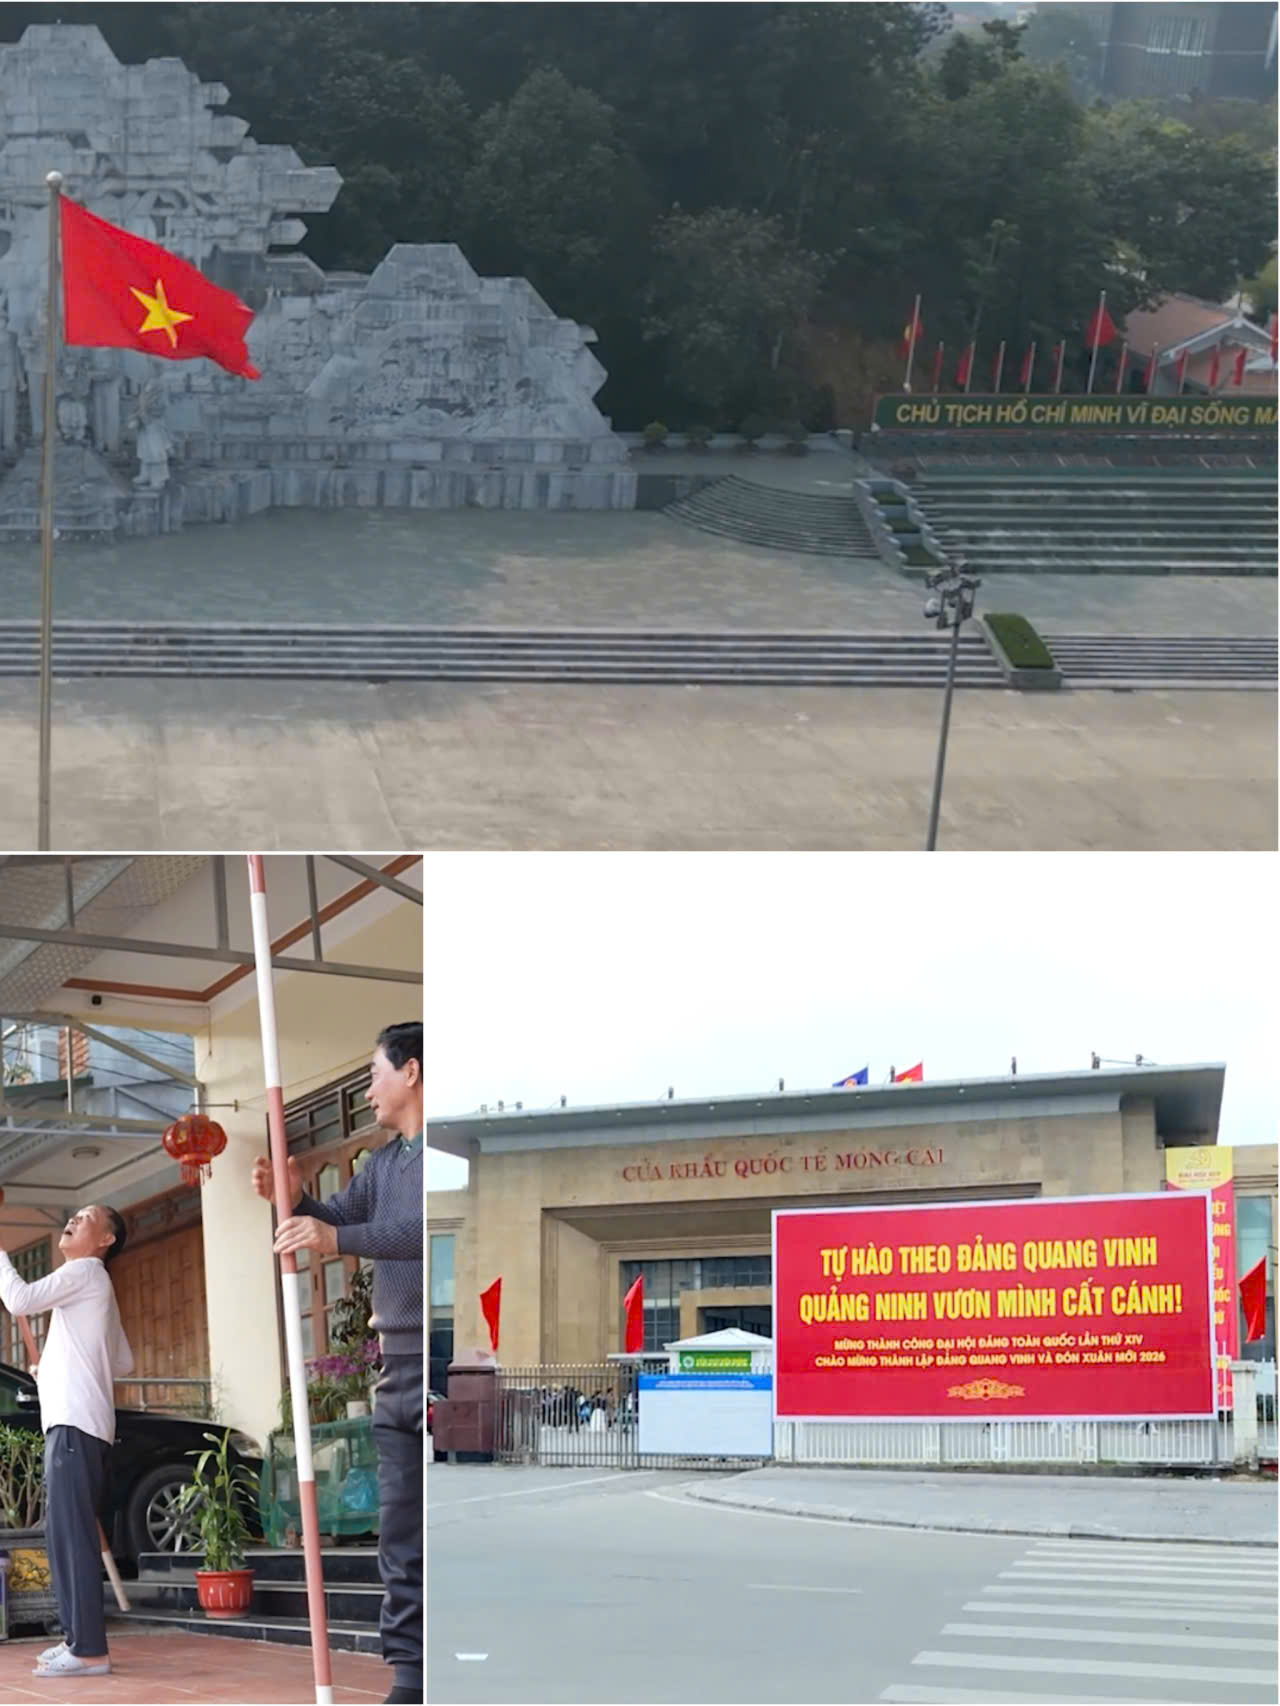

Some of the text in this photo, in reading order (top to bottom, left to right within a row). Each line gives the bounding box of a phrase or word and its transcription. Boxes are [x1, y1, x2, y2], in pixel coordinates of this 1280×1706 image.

[896, 398, 941, 423] CHỦ
[945, 404, 992, 428] TỊCH
[996, 398, 1029, 423] HỒ
[1031, 400, 1068, 423] CHÍ
[1071, 405, 1122, 424] MINH
[1126, 402, 1149, 424] VĨ
[1151, 405, 1188, 429] ĐẠI
[1190, 400, 1251, 425] SỐNG
[622, 1157, 663, 1182] CỬA
[670, 1152, 728, 1180] KHẨU
[734, 1149, 793, 1179] QUỐC
[800, 1146, 828, 1173] TẾ
[820, 1234, 1158, 1282] TỰ HÀO THEO ĐẢNG QUANG VINH
[799, 1277, 1183, 1326] QUẢNG NINH VƯƠN MÌNH CẤT CÁNH!
[833, 1331, 1144, 1351] MỪNG THÀNH CÔNG ĐẠI HỘI ĐẢNG TOÀN QUỐC LẦN THỨ XIV
[815, 1349, 1166, 1369] CHÀO MỪNG THÀNH LẬP ĐẢNG QUANG VINH VÀ ĐÓN XUÂN MỚI 2026
